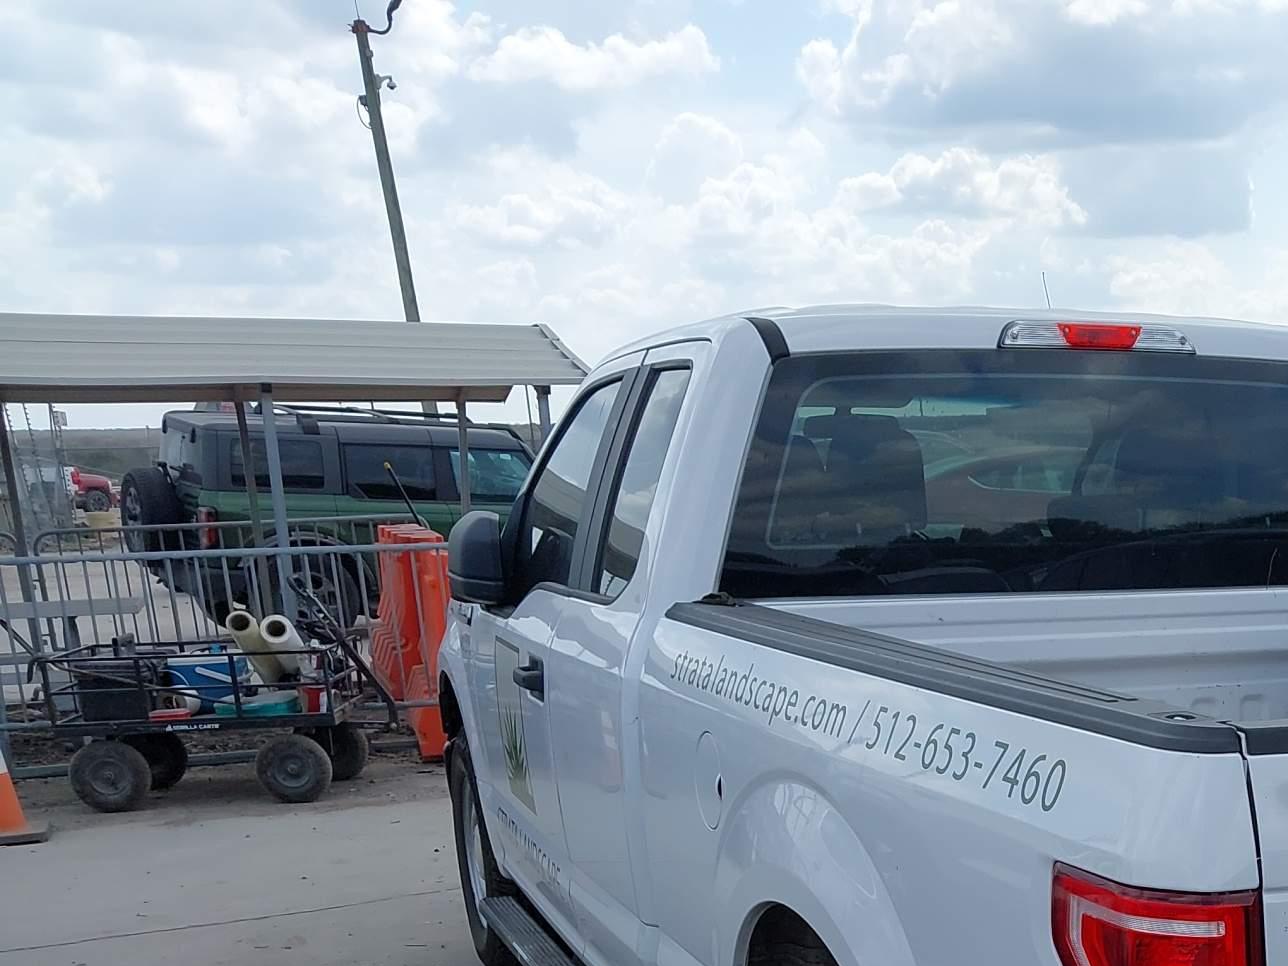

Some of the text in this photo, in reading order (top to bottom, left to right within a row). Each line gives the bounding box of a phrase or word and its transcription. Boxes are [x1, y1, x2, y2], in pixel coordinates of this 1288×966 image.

[669, 650, 1067, 813] stratalandscape.com / 512-653-7460
